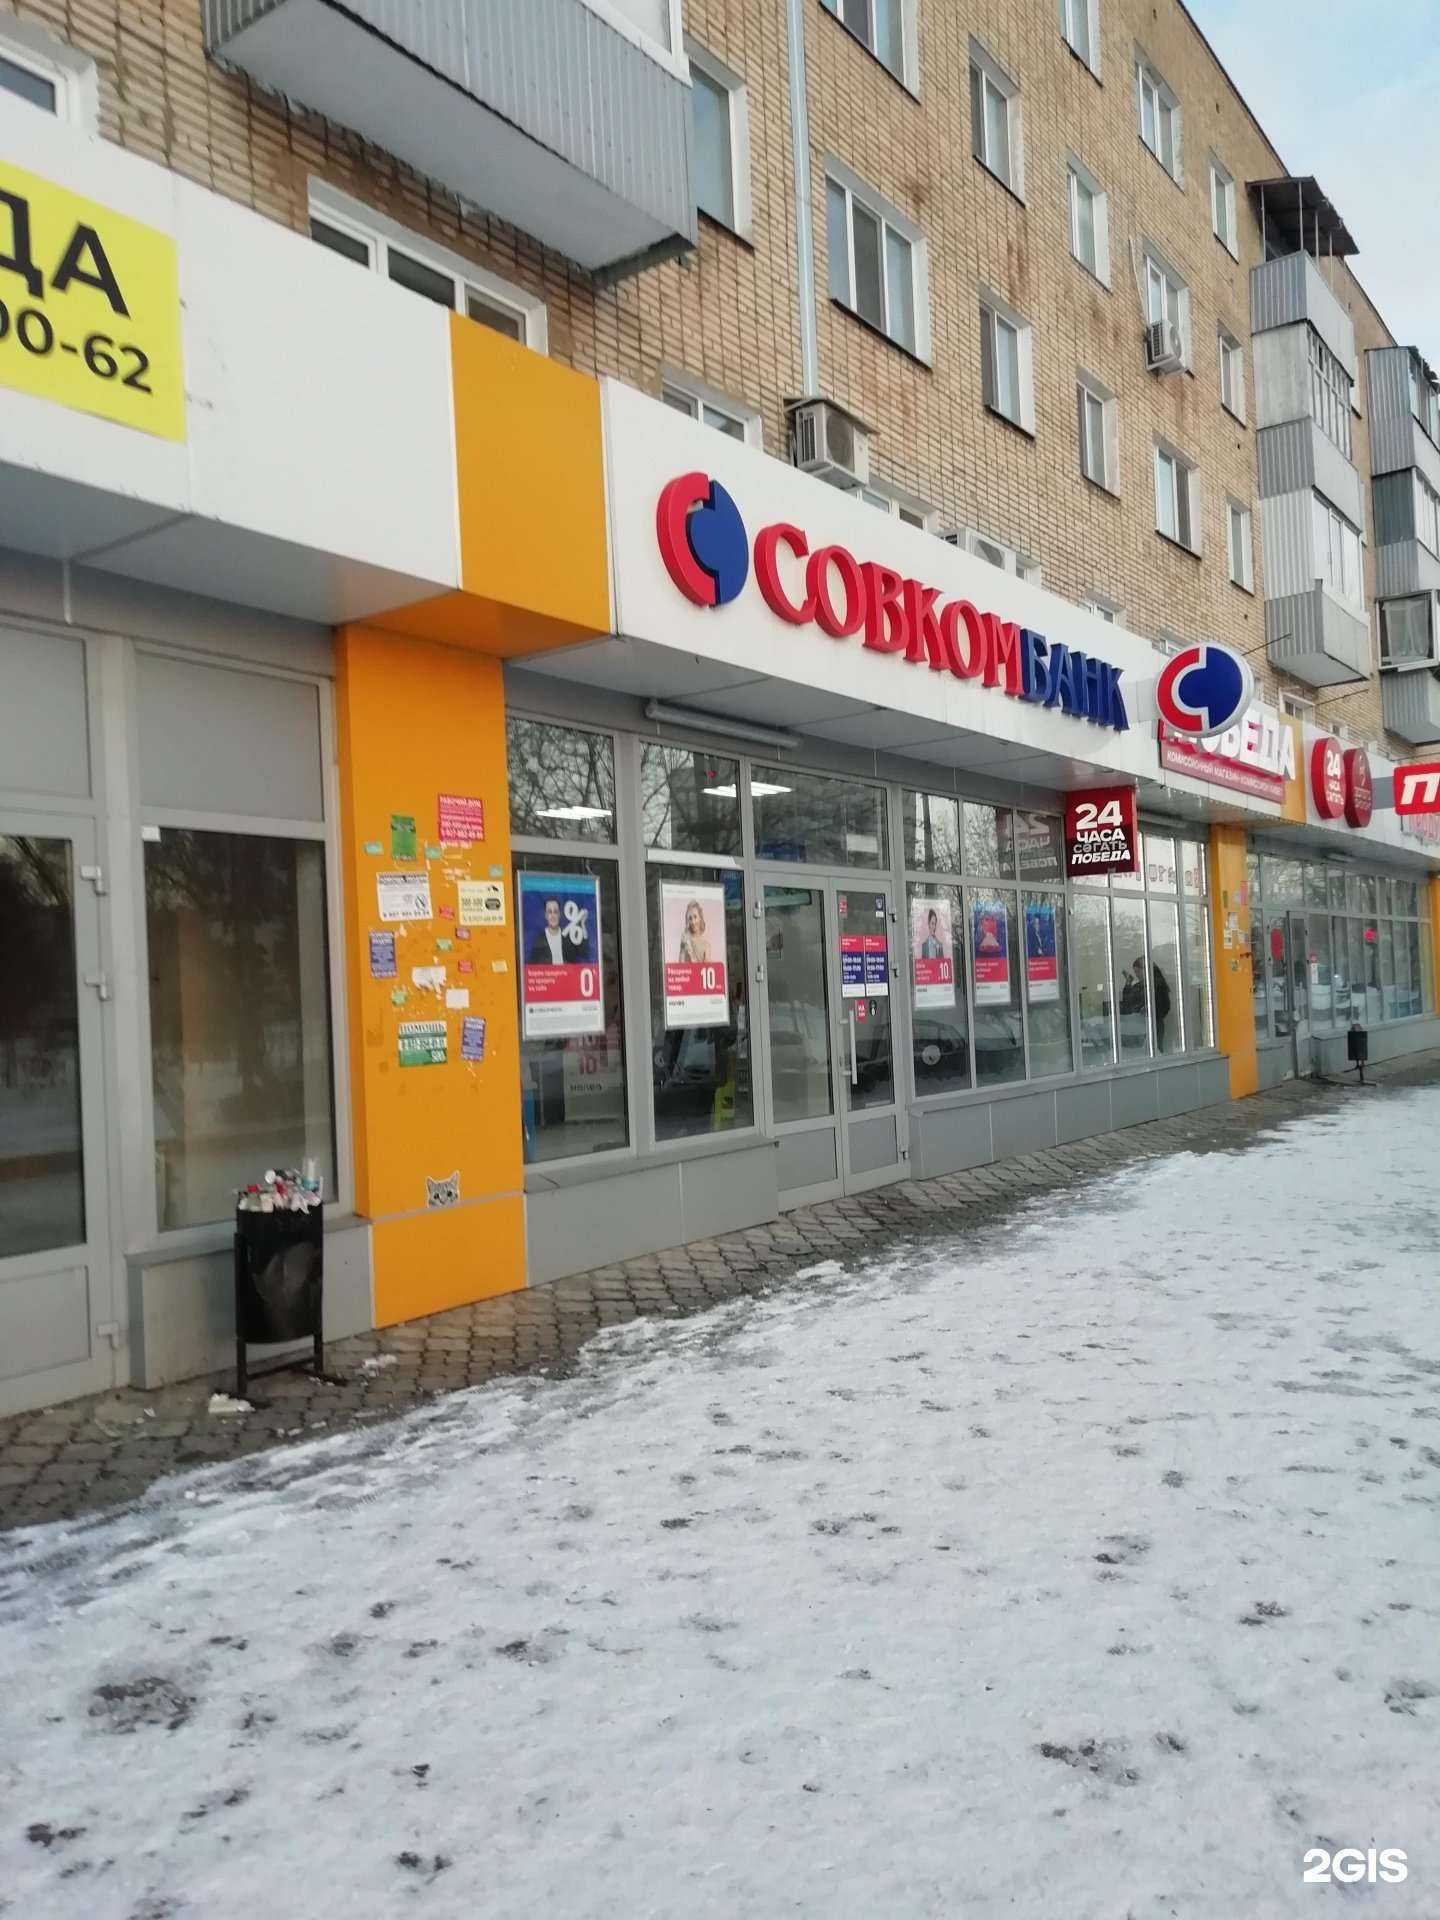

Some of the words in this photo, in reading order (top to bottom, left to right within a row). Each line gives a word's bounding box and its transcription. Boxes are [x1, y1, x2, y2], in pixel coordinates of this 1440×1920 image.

[0, 299, 154, 395] 0-62
[753, 522, 1130, 732] СОВКОМБАНК
[1326, 749, 1341, 779] 24
[1075, 800, 1123, 830] 24
[1076, 828, 1126, 844] ЧАСА
[1071, 849, 1131, 865] ПОБЕДА
[700, 967, 716, 990] 10
[939, 962, 949, 980] 10
